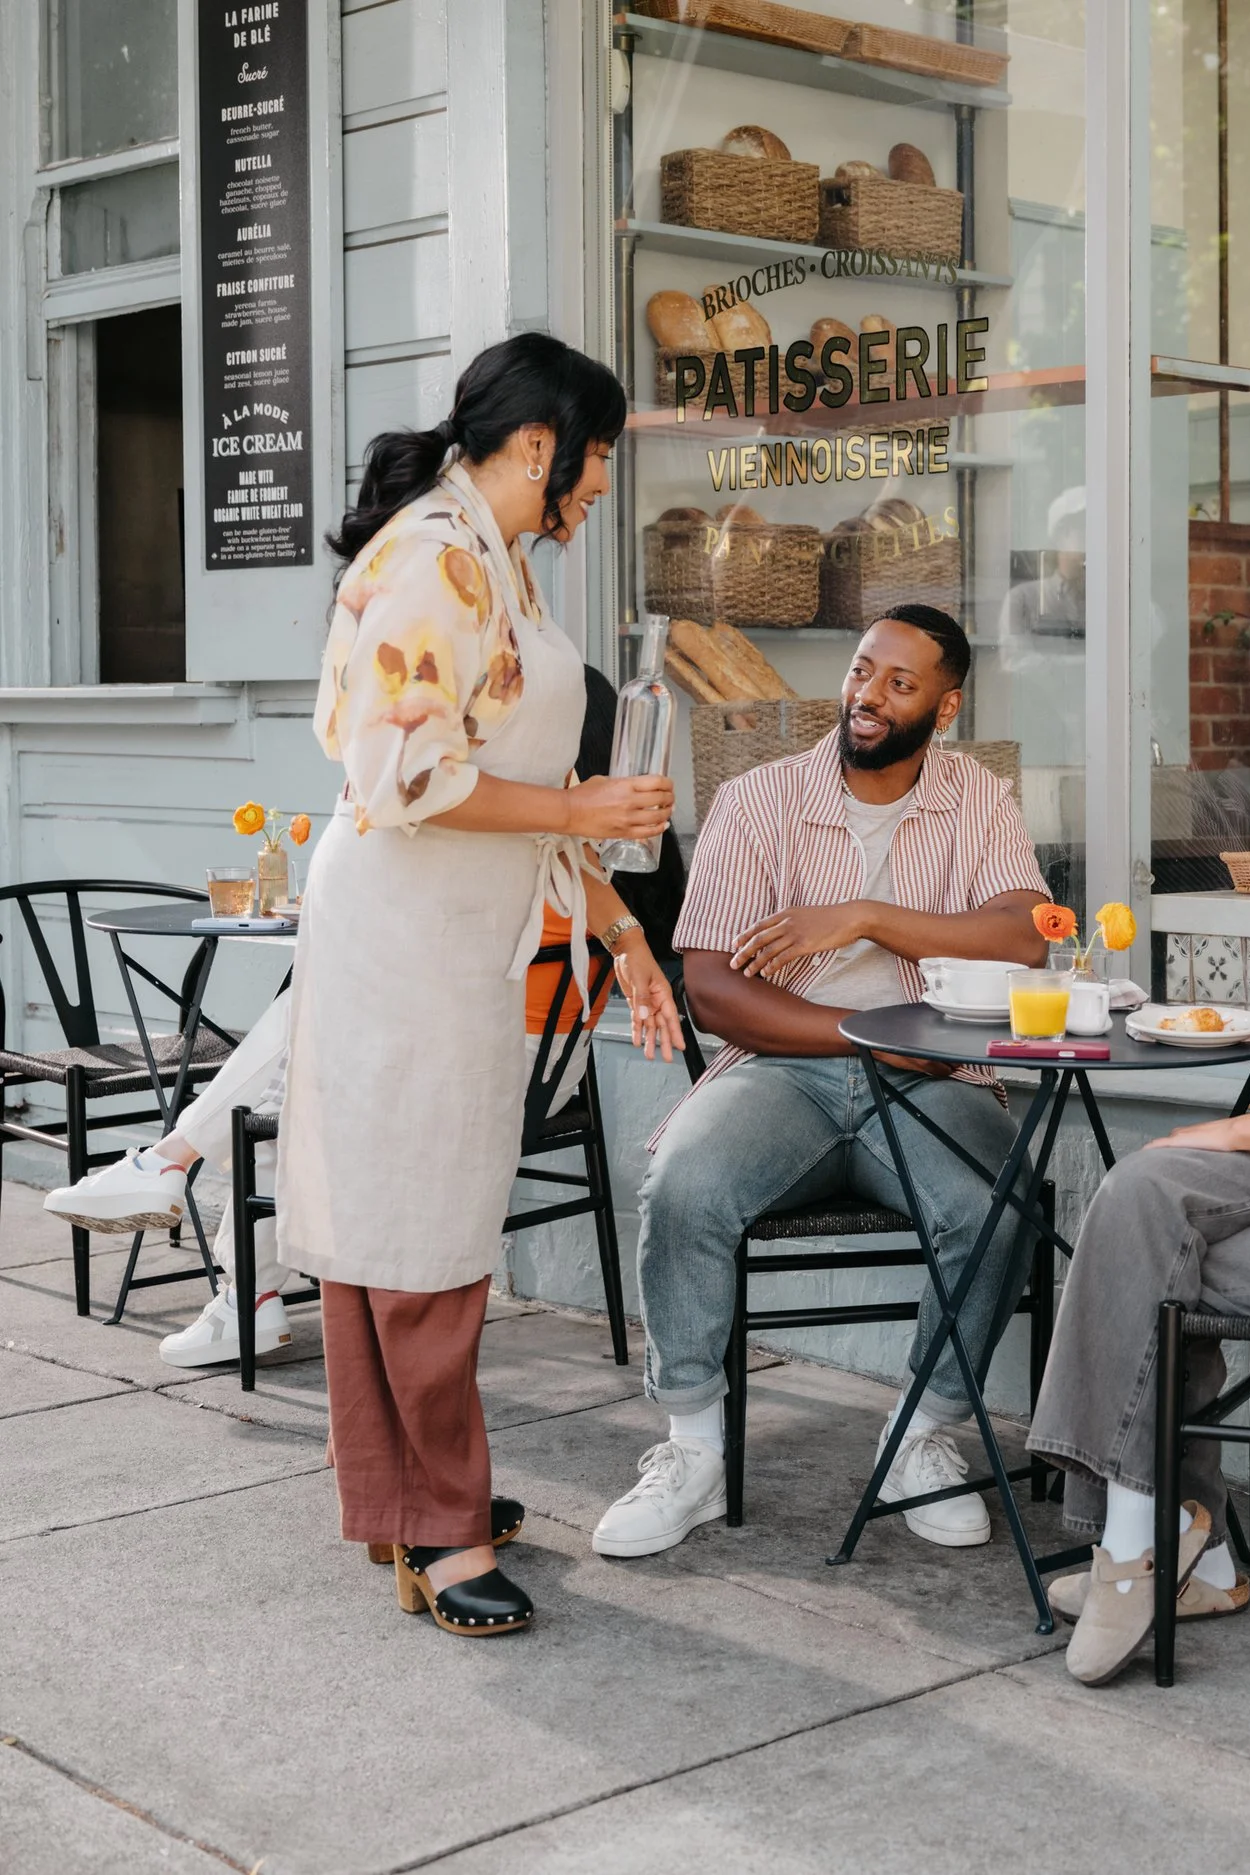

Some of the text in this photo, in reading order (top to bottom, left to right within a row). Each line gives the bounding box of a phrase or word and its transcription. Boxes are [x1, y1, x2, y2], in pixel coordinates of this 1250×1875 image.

[225, 2, 279, 28] LA FARINE
[233, 24, 271, 48] DE BLÉ
[237, 62, 268, 84] Sucré
[226, 130, 280, 144] cassonade sugar
[230, 126, 251, 136] french
[235, 154, 272, 173] NUTELLA
[227, 179, 254, 189] chocolat
[255, 182, 282, 194] chopped
[237, 222, 272, 242] AURÉLIA
[217, 249, 243, 260] caramel
[254, 246, 275, 255] beurre
[246, 255, 254, 264] de
[217, 274, 295, 297] FRAISE CONFITURE
[701, 249, 959, 322] BRIOCHES CROISSANTS
[221, 319, 239, 328] made
[226, 343, 287, 366] CITRON SUCRÉ
[224, 368, 289, 382] seasonal lemon juice
[675, 317, 989, 423] PATISSERIE
[224, 381, 236, 389] and
[222, 402, 290, 430] À LA MODE
[212, 431, 304, 457] ICE CREAM
[707, 426, 950, 491] VIENNOISERIE
[239, 469, 274, 485] MADE WITH
[227, 486, 288, 504] FARINE DE FROMENT
[213, 503, 303, 523] ORGANIC WHITE WHEAT FLOUR
[241, 535, 271, 544] buckwheat
[242, 528, 258, 536] made
[220, 545, 236, 553] made
[251, 543, 275, 552] separate
[277, 549, 297, 558] facility
